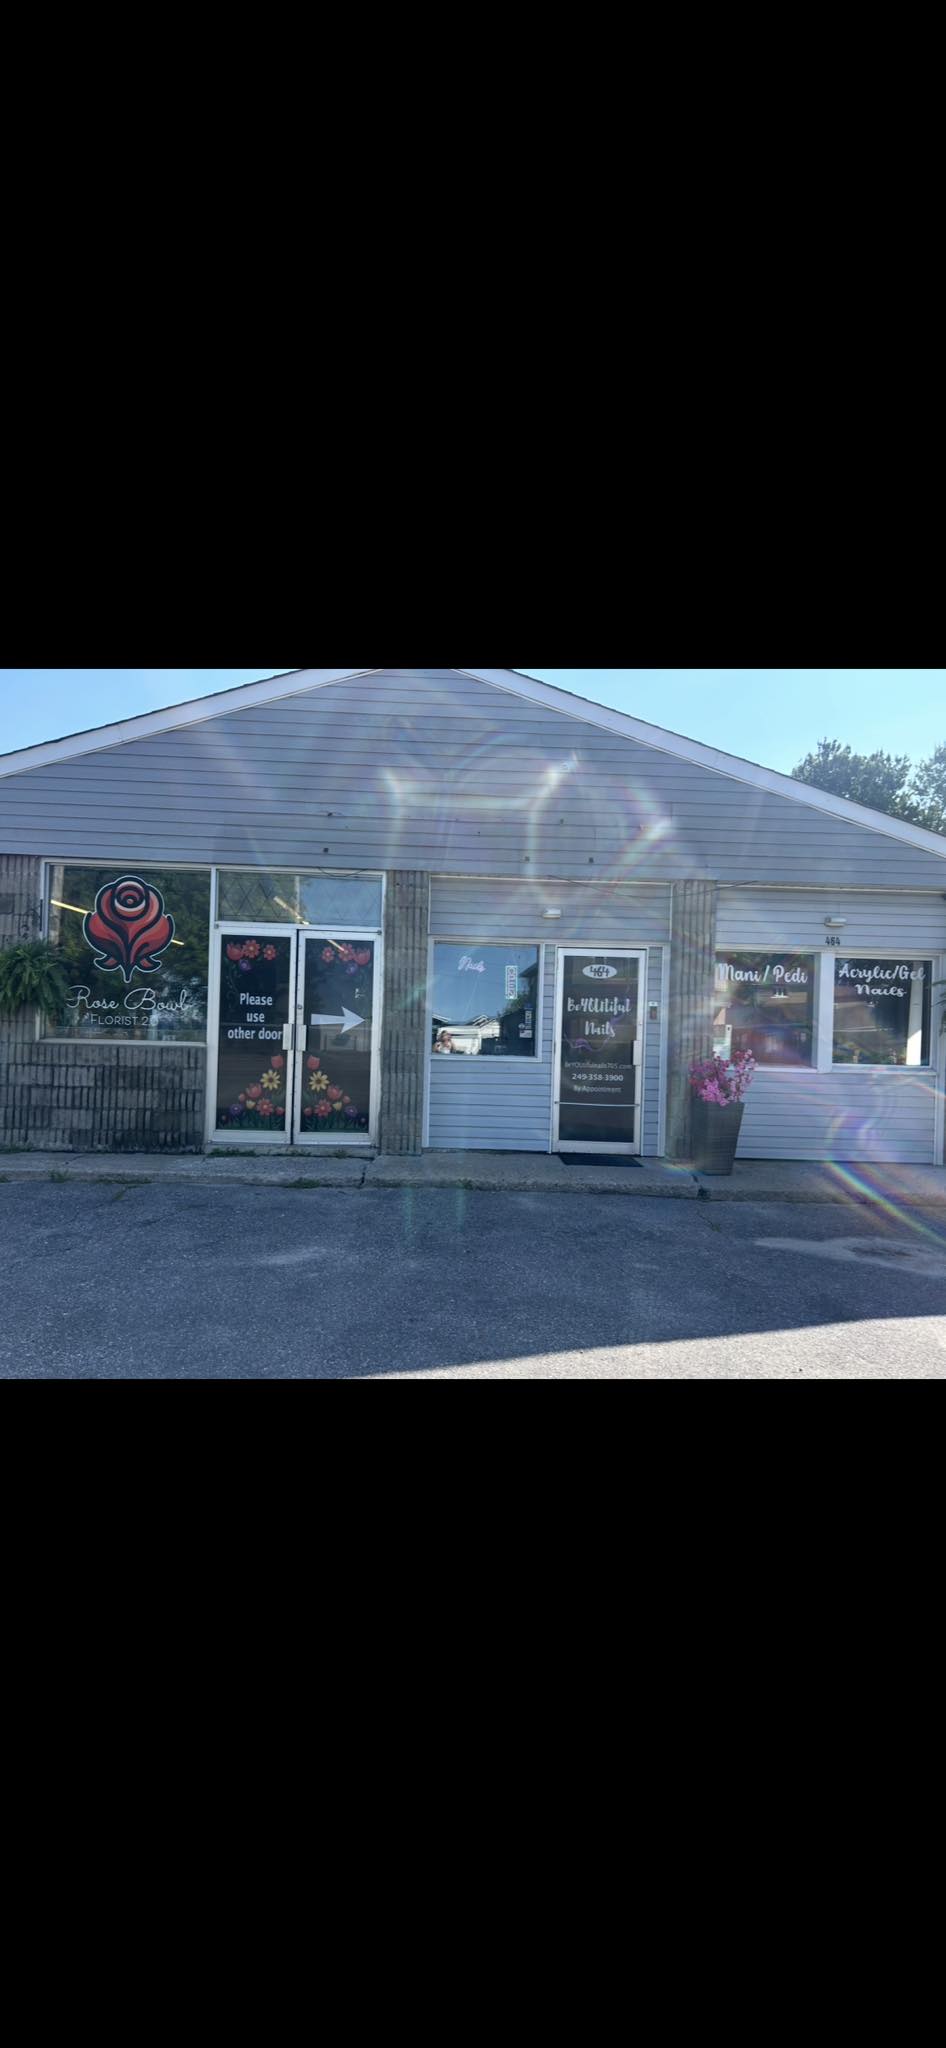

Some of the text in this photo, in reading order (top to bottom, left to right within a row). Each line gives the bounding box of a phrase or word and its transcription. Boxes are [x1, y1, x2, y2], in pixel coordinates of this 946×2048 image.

[824, 936, 841, 946] 464
[590, 966, 610, 977] 464
[718, 962, 761, 983] Mani
[772, 964, 808, 983] Pedi
[65, 984, 193, 1011] Rose Bowl
[854, 983, 907, 998] Nails
[239, 992, 273, 1006] Please
[246, 1011, 265, 1023] use
[227, 1026, 283, 1040] other door
[584, 1020, 616, 1038] Nails
